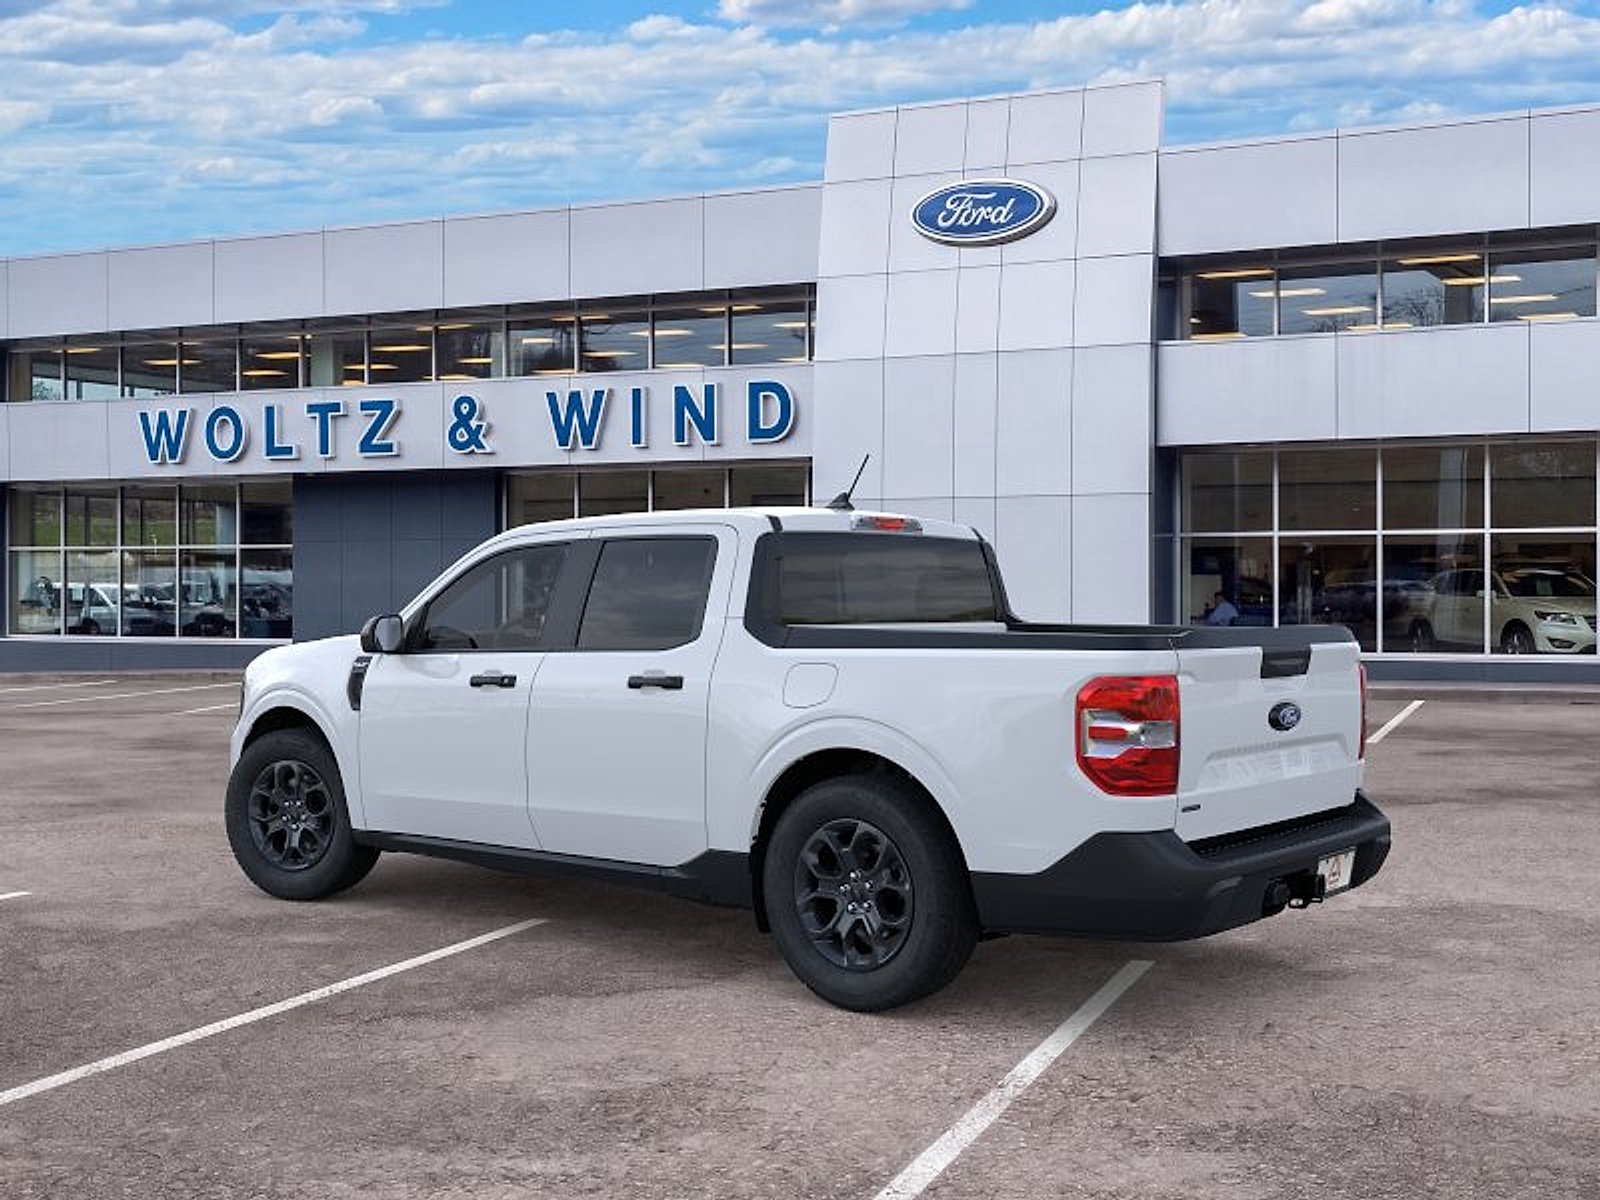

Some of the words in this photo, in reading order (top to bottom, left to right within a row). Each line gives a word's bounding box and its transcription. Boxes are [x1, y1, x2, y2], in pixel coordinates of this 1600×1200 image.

[937, 192, 1015, 228] Ford
[138, 399, 402, 465] WOLTZ
[447, 393, 494, 454] &
[545, 378, 796, 450] WIND
